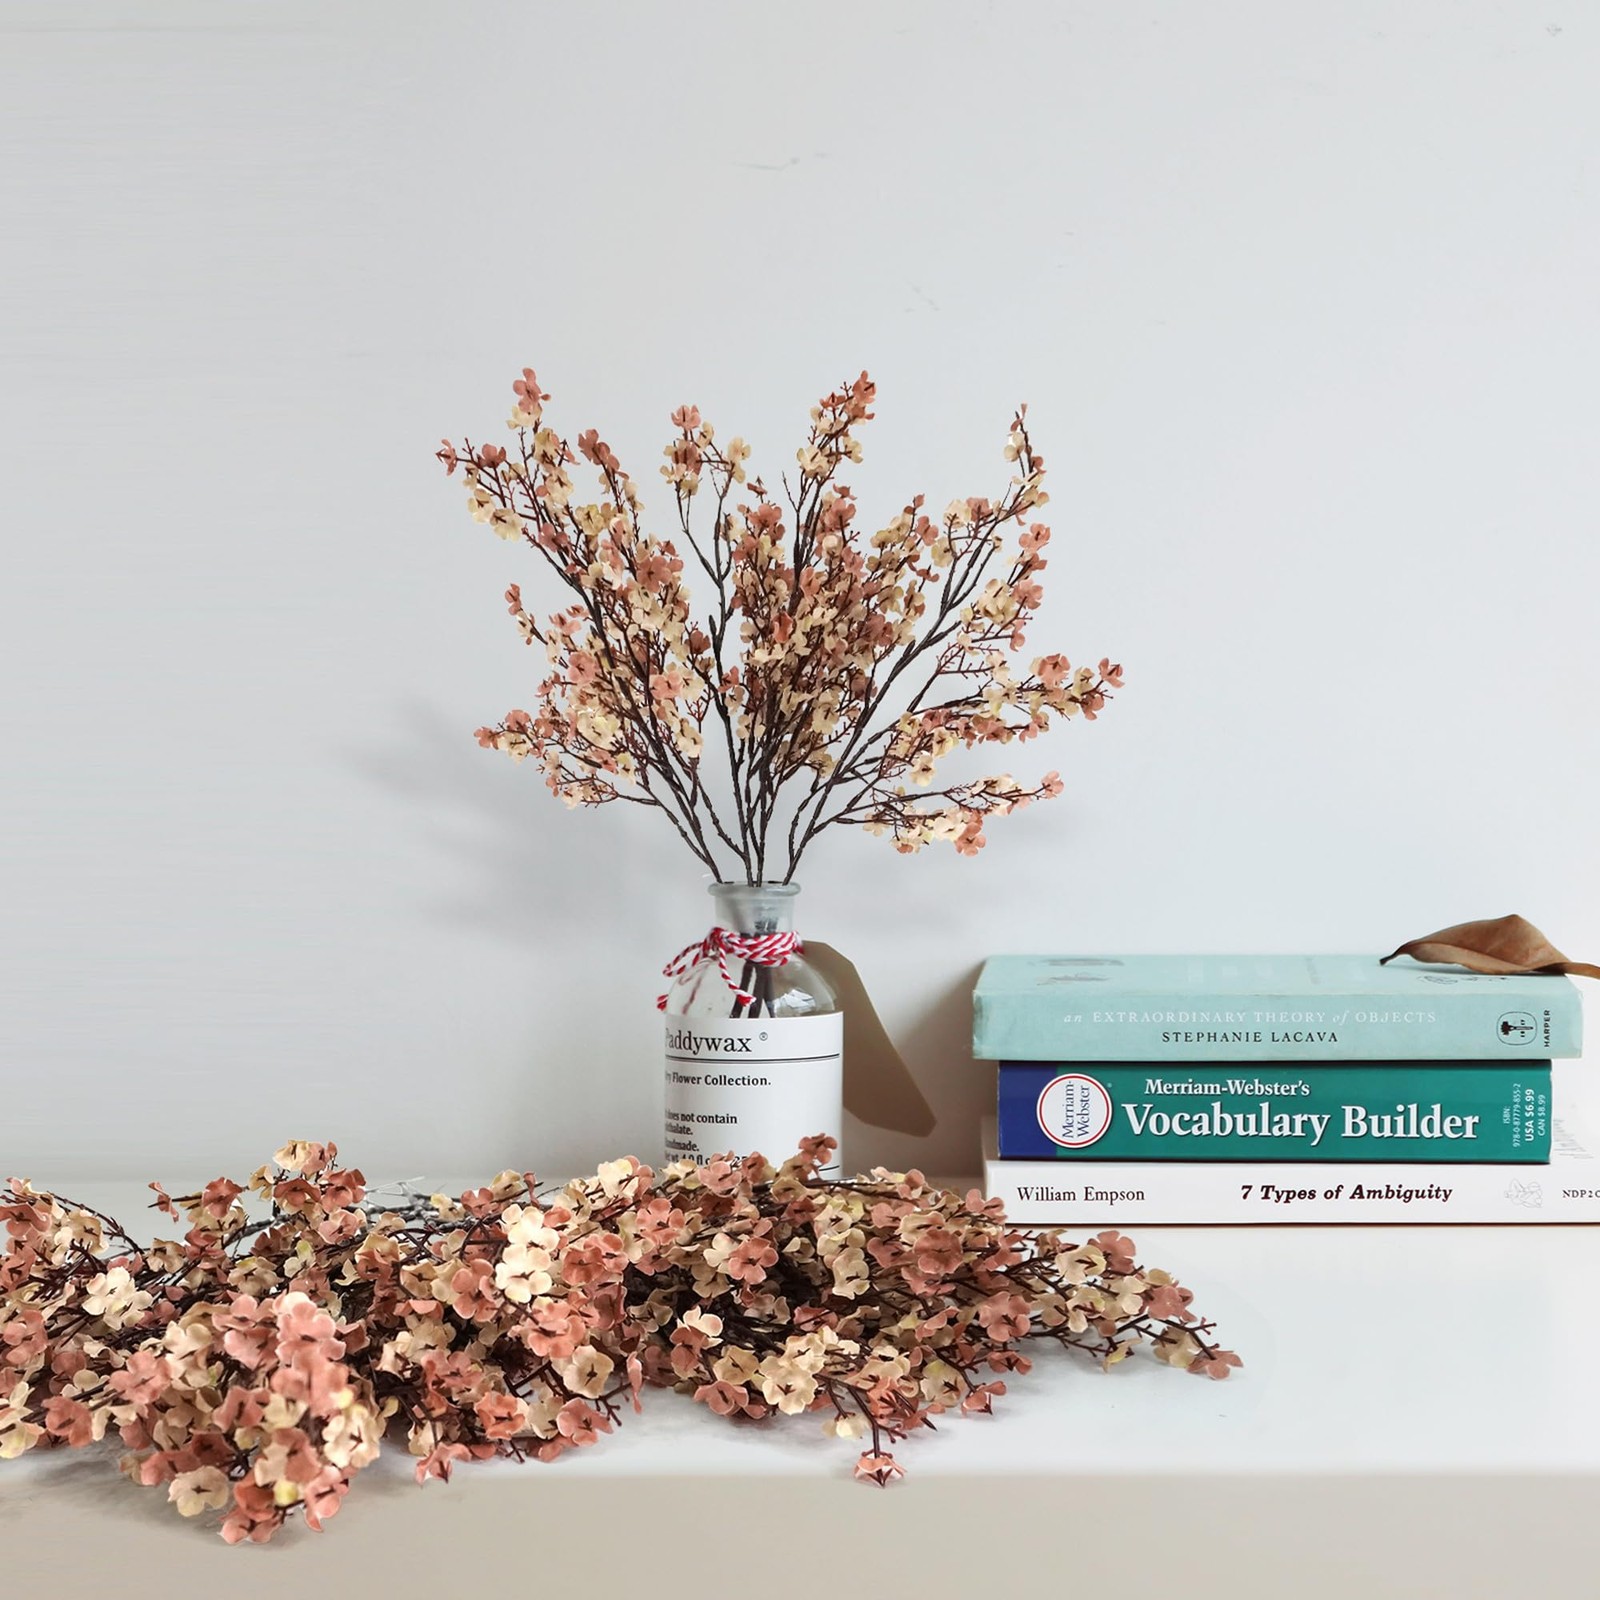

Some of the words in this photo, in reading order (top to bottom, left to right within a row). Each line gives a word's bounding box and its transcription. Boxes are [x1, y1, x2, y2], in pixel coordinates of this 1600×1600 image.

[1063, 1013, 1082, 1023] an
[1092, 1011, 1247, 1023] EXTRAORDINARY
[1253, 1011, 1326, 1023] THEORY
[1332, 1010, 1350, 1026] of
[1355, 1011, 1437, 1023] OBJECTS
[1162, 1031, 1262, 1043] STEPHANIE
[1271, 1031, 1339, 1043] LACAVA
[1543, 1009, 1551, 1048] HARPER
[672, 1071, 702, 1085] Flower
[704, 1074, 772, 1086] Collection.
[1144, 1078, 1311, 1096] Merriam-Webster's
[1062, 1080, 1075, 1139] Merriam-
[1076, 1085, 1091, 1138] Webster
[1524, 1088, 1535, 1118] $6.99
[1537, 1094, 1546, 1117] $8.99
[680, 1113, 695, 1123] not
[696, 1113, 738, 1124] contain
[1121, 1101, 1331, 1146] Vocabulary
[1341, 1103, 1480, 1139] Builder
[1502, 1105, 1511, 1125] ISBN:
[1524, 1119, 1535, 1142] USA
[1537, 1118, 1546, 1137] CAN
[1017, 1186, 1077, 1201] William
[1084, 1186, 1146, 1205] Empson
[1241, 1184, 1253, 1200] 7
[1260, 1184, 1317, 1203] Types
[1323, 1184, 1345, 1200] of
[1349, 1184, 1453, 1203] Ambiguity
